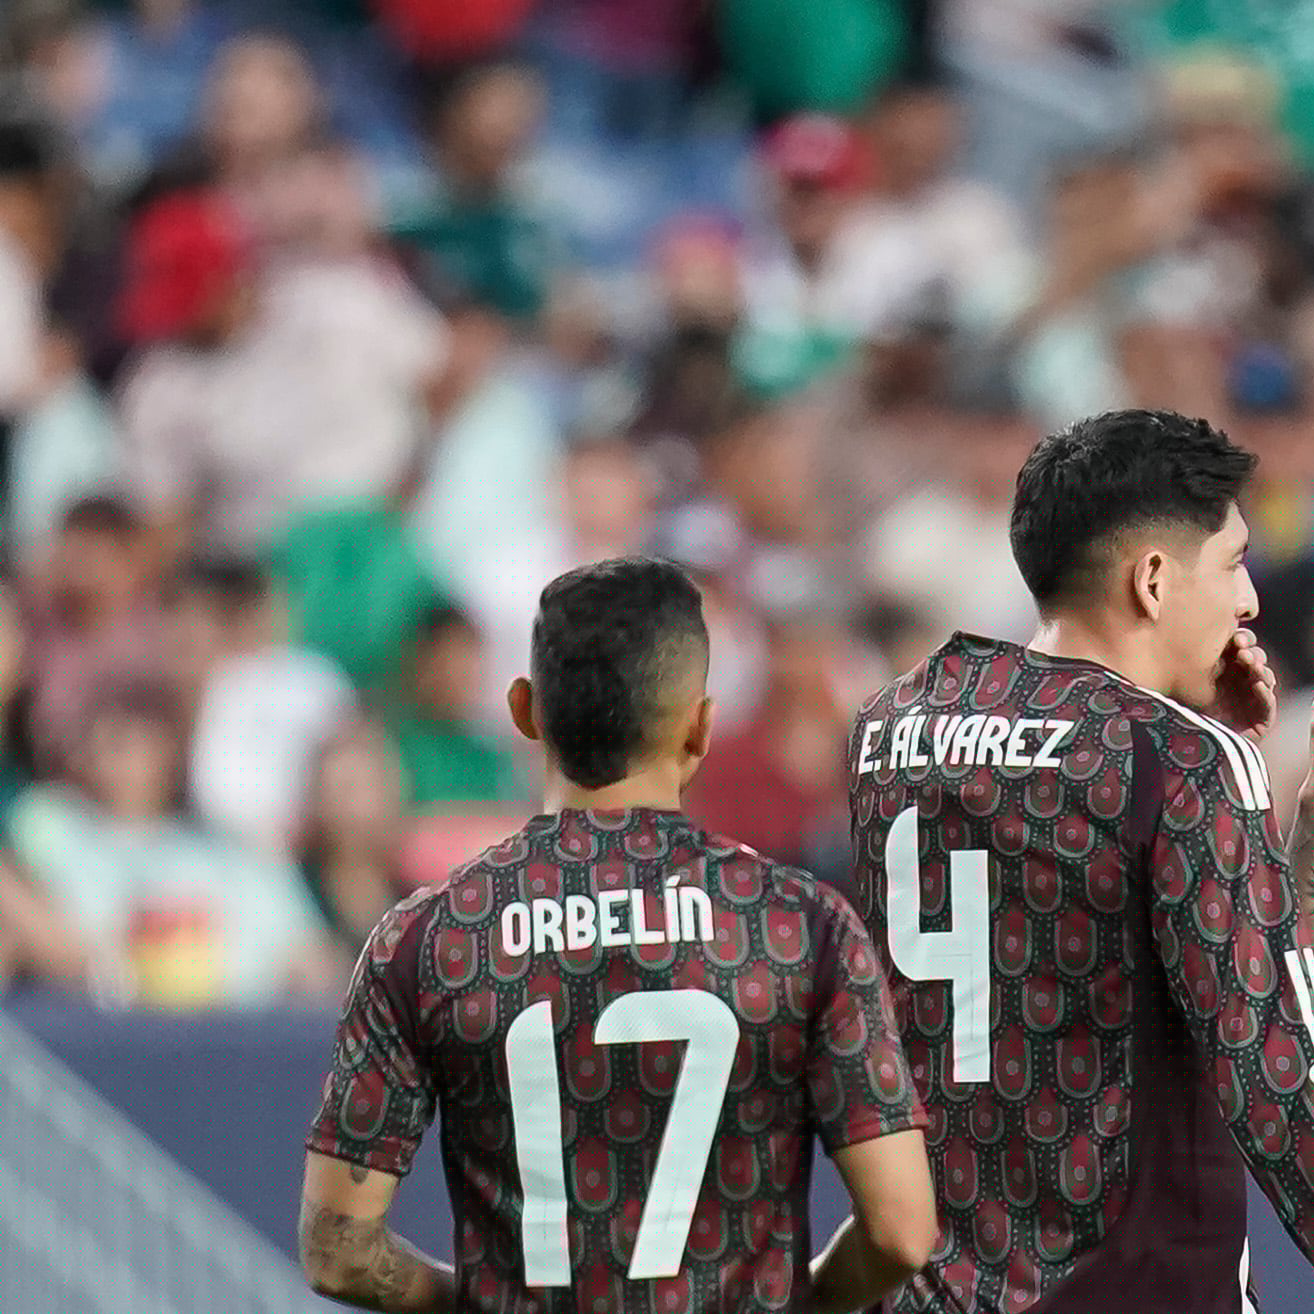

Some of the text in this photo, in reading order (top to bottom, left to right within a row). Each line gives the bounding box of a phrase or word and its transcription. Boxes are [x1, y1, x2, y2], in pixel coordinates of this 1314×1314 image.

[889, 706, 1075, 769] ÁLVAREZ
[885, 806, 990, 1083] 4
[504, 988, 741, 1288] 17
